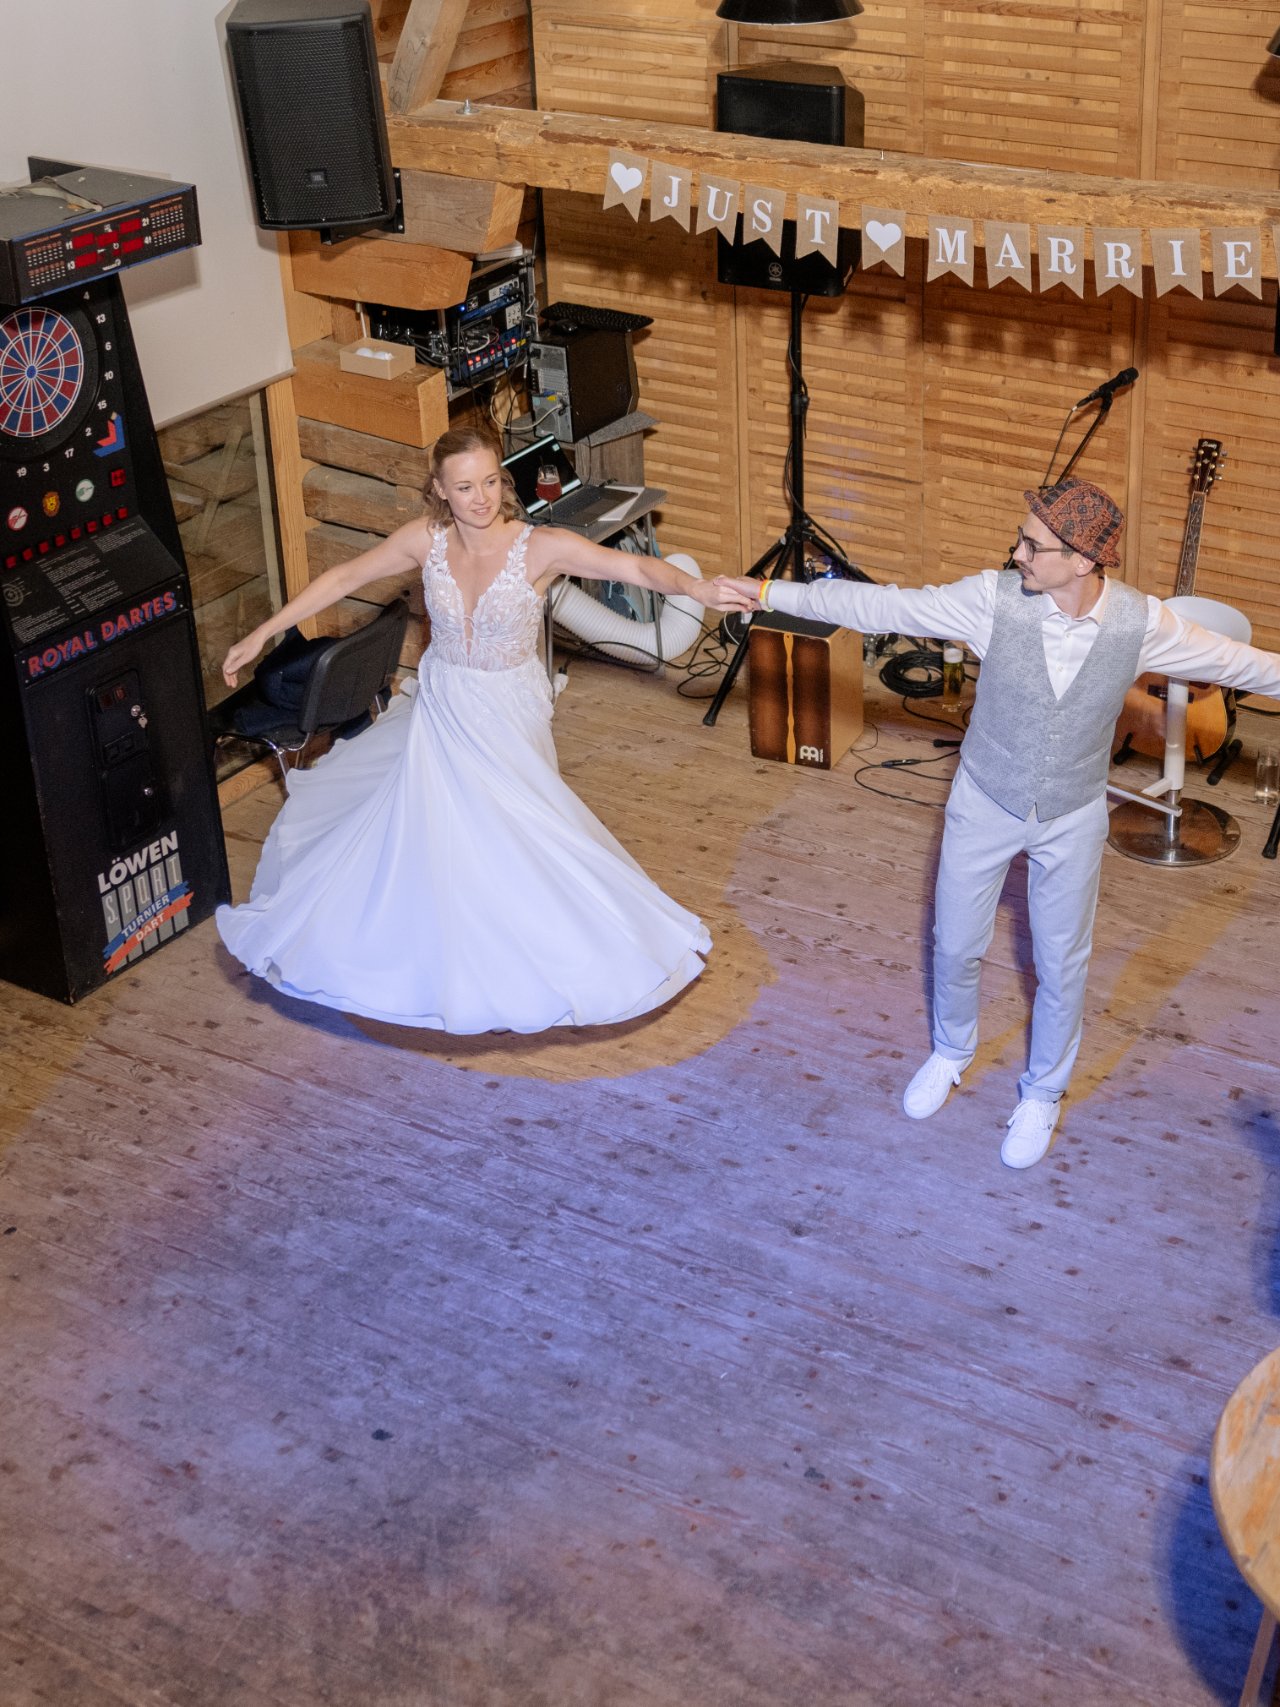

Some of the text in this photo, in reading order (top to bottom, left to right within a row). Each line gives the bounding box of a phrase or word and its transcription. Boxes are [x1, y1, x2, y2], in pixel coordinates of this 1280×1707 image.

[663, 175, 830, 244] JUST
[83, 291, 90, 300] 4
[96, 314, 106, 324] 13
[105, 341, 112, 350] 6
[104, 370, 114, 380] 10
[97, 400, 108, 410] 15
[85, 427, 92, 437] 2
[64, 447, 74, 459] 17
[16, 467, 27, 477] 19
[43, 463, 50, 472] 3
[27, 630, 97, 677] ROYAL
[101, 591, 177, 641] DARTES
[97, 830, 179, 894] LÖWEN
[121, 894, 170, 938] TURNIER
[135, 912, 165, 942] DART
